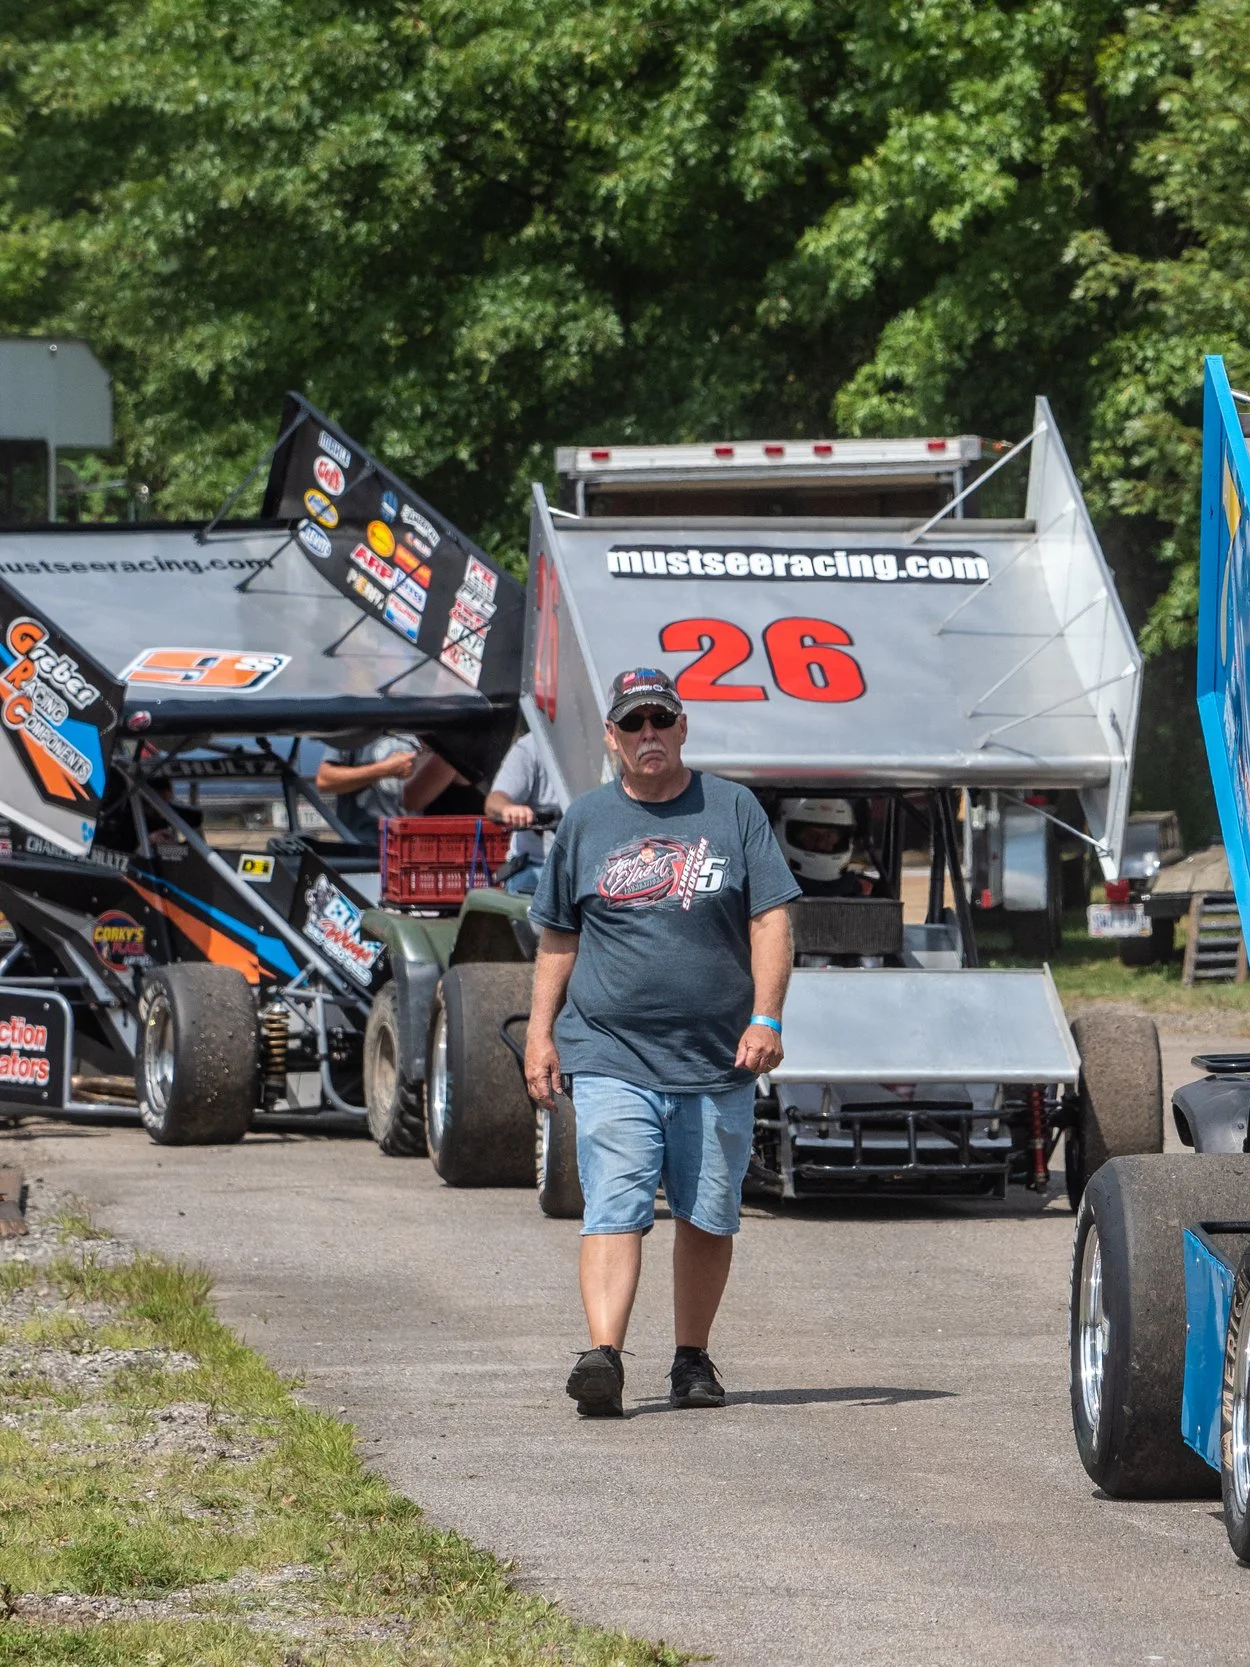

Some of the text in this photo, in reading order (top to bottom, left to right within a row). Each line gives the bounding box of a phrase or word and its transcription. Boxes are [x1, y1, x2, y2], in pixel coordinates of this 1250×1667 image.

[353, 546, 394, 581] ARP
[606, 545, 989, 581] mustseeracing.com
[658, 616, 866, 702] 26
[3, 657, 69, 725] RACING
[4, 695, 92, 783] COMPONENTS
[606, 854, 642, 887] Tony
[609, 851, 680, 897] Elliott
[677, 845, 698, 898] CHASE
[682, 836, 709, 912] STOCKON
[693, 856, 729, 894] 5
[94, 926, 144, 942] CORKY'S
